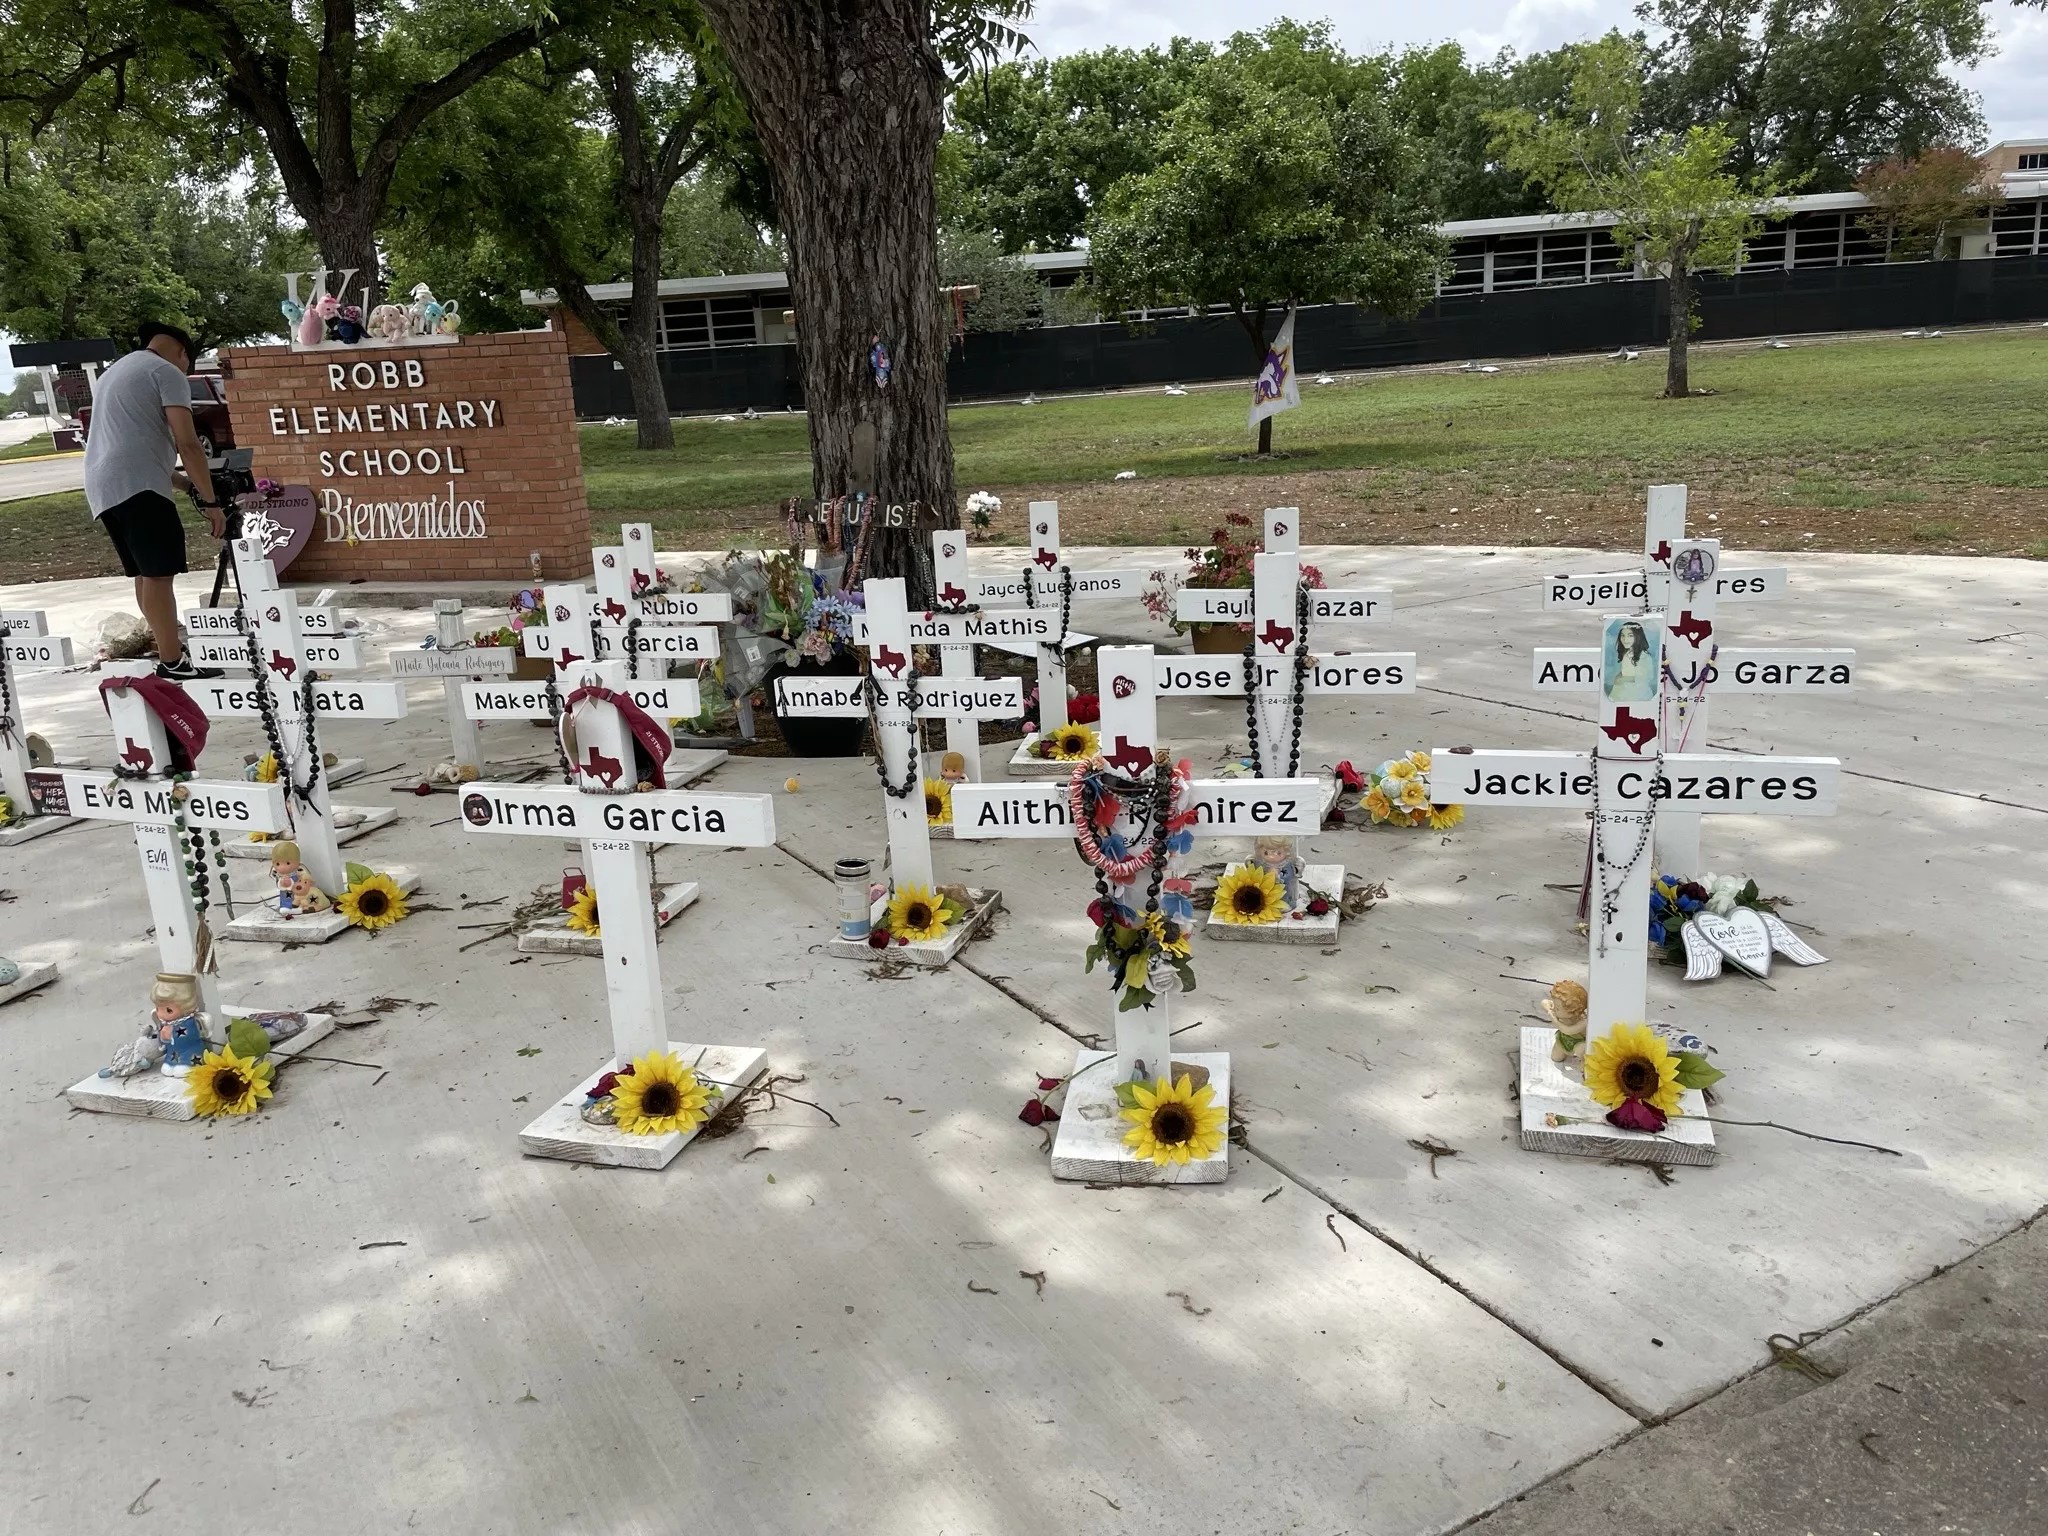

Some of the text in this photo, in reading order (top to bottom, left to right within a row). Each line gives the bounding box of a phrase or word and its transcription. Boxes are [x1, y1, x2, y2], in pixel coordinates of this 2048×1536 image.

[328, 360, 424, 391] ROBB
[269, 400, 496, 435] ELEMENTARY
[319, 447, 464, 477] SCHOOL
[267, 498, 309, 509] STRONG
[321, 481, 487, 541] Bienvenidos
[885, 504, 904, 527] IS
[979, 578, 1121, 597] Jayce Luevanos
[1552, 581, 1647, 604] Rojelio
[641, 600, 698, 615] Rubio
[1205, 599, 1250, 618] Layl
[965, 617, 1048, 637] Mathis
[200, 645, 250, 661] Jailah
[465, 655, 505, 672] Rodriguez
[1681, 661, 1718, 684] Jo
[1735, 661, 1851, 684] Garza
[1159, 664, 1403, 687] Jose Jr lores
[475, 691, 565, 710] Makenn
[897, 690, 1017, 711] Rodriguez
[1464, 769, 1819, 800] Jackie Cazares
[83, 784, 250, 820] Eva Mieles
[493, 797, 576, 827] Irma
[604, 802, 726, 833] Garcia
[136, 824, 166, 834] 5-24-22
[592, 842, 630, 850] 5-24-22
[146, 848, 168, 867] EVA
[1709, 925, 1740, 941] love
[1736, 948, 1768, 961] home
